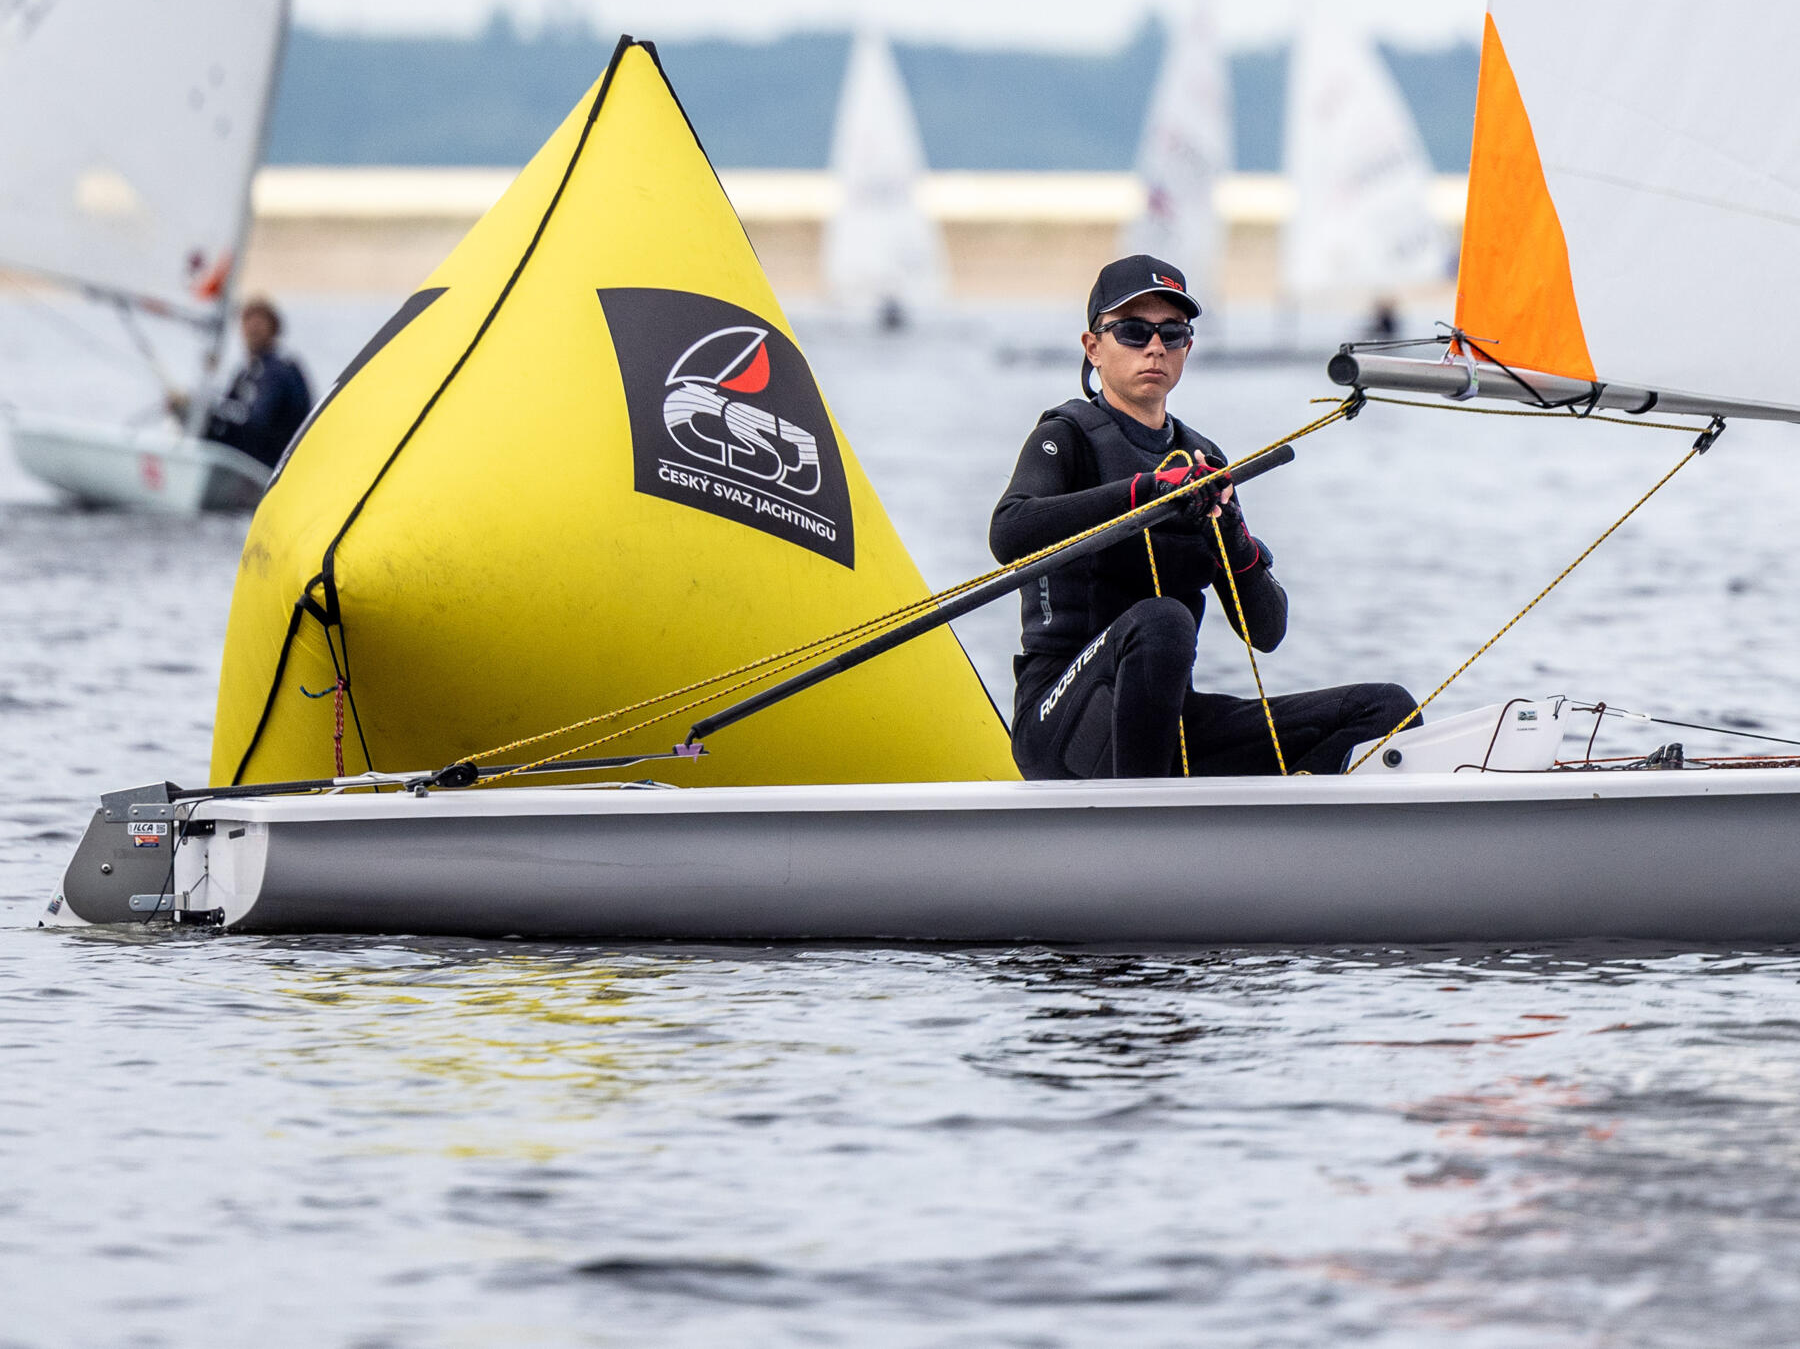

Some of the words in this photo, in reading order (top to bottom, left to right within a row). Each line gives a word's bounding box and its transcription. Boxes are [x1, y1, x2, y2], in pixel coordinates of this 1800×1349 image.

[658, 464, 711, 493] ČESKÝ
[713, 482, 753, 508] SVAZ
[755, 497, 837, 542] JACHTINGU
[1040, 630, 1108, 722] ROOSTER
[133, 823, 154, 832] ILCA
